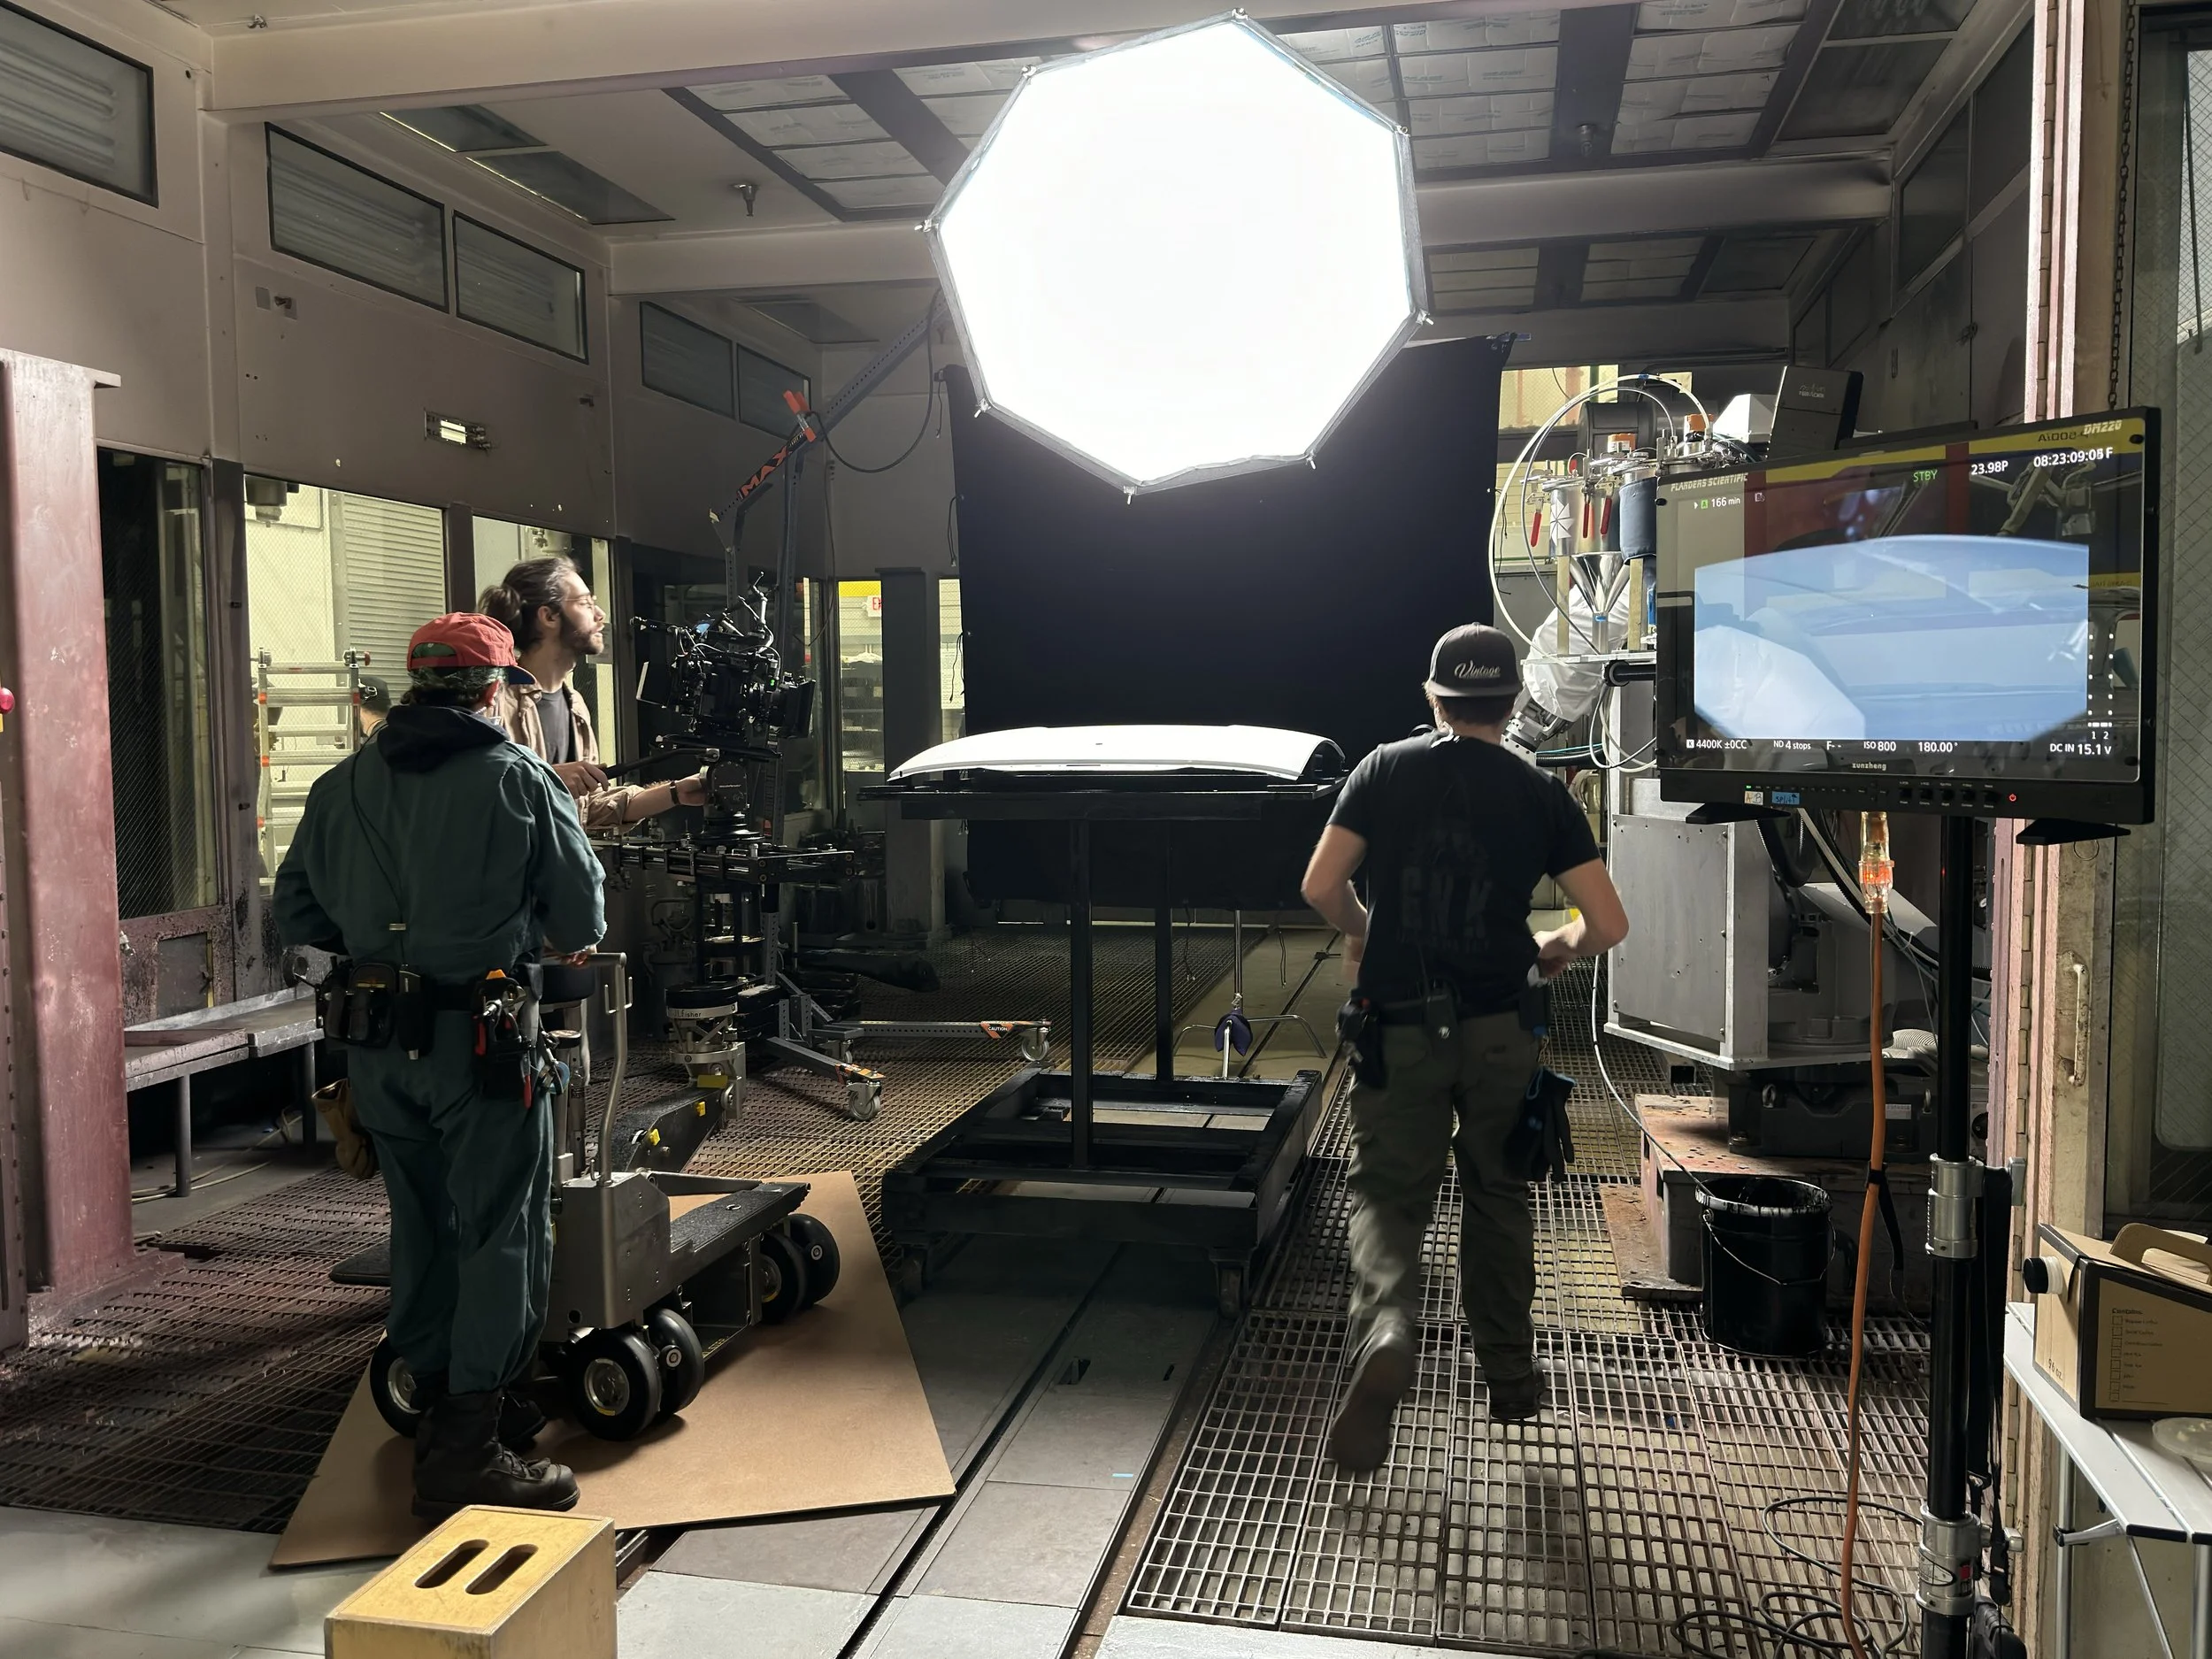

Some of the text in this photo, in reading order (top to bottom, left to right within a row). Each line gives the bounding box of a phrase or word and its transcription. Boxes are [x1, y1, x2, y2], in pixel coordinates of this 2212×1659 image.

[1970, 460, 2008, 476] 23.98P
[1913, 469, 1938, 482] STBY
[1671, 472, 1748, 492] FLANDERS SCIENTIFIC
[1711, 496, 1727, 508] 166
[2091, 731, 2109, 740] 1 2
[1695, 739, 1723, 749] 4400K
[1773, 740, 1811, 750] ND 4 stops
[1863, 741, 1897, 752] ISO 800
[2049, 742, 2063, 753] DC
[2064, 743, 2075, 753] IN
[2078, 743, 2101, 756] 15.1
[2048, 1358, 2055, 1372] 96
